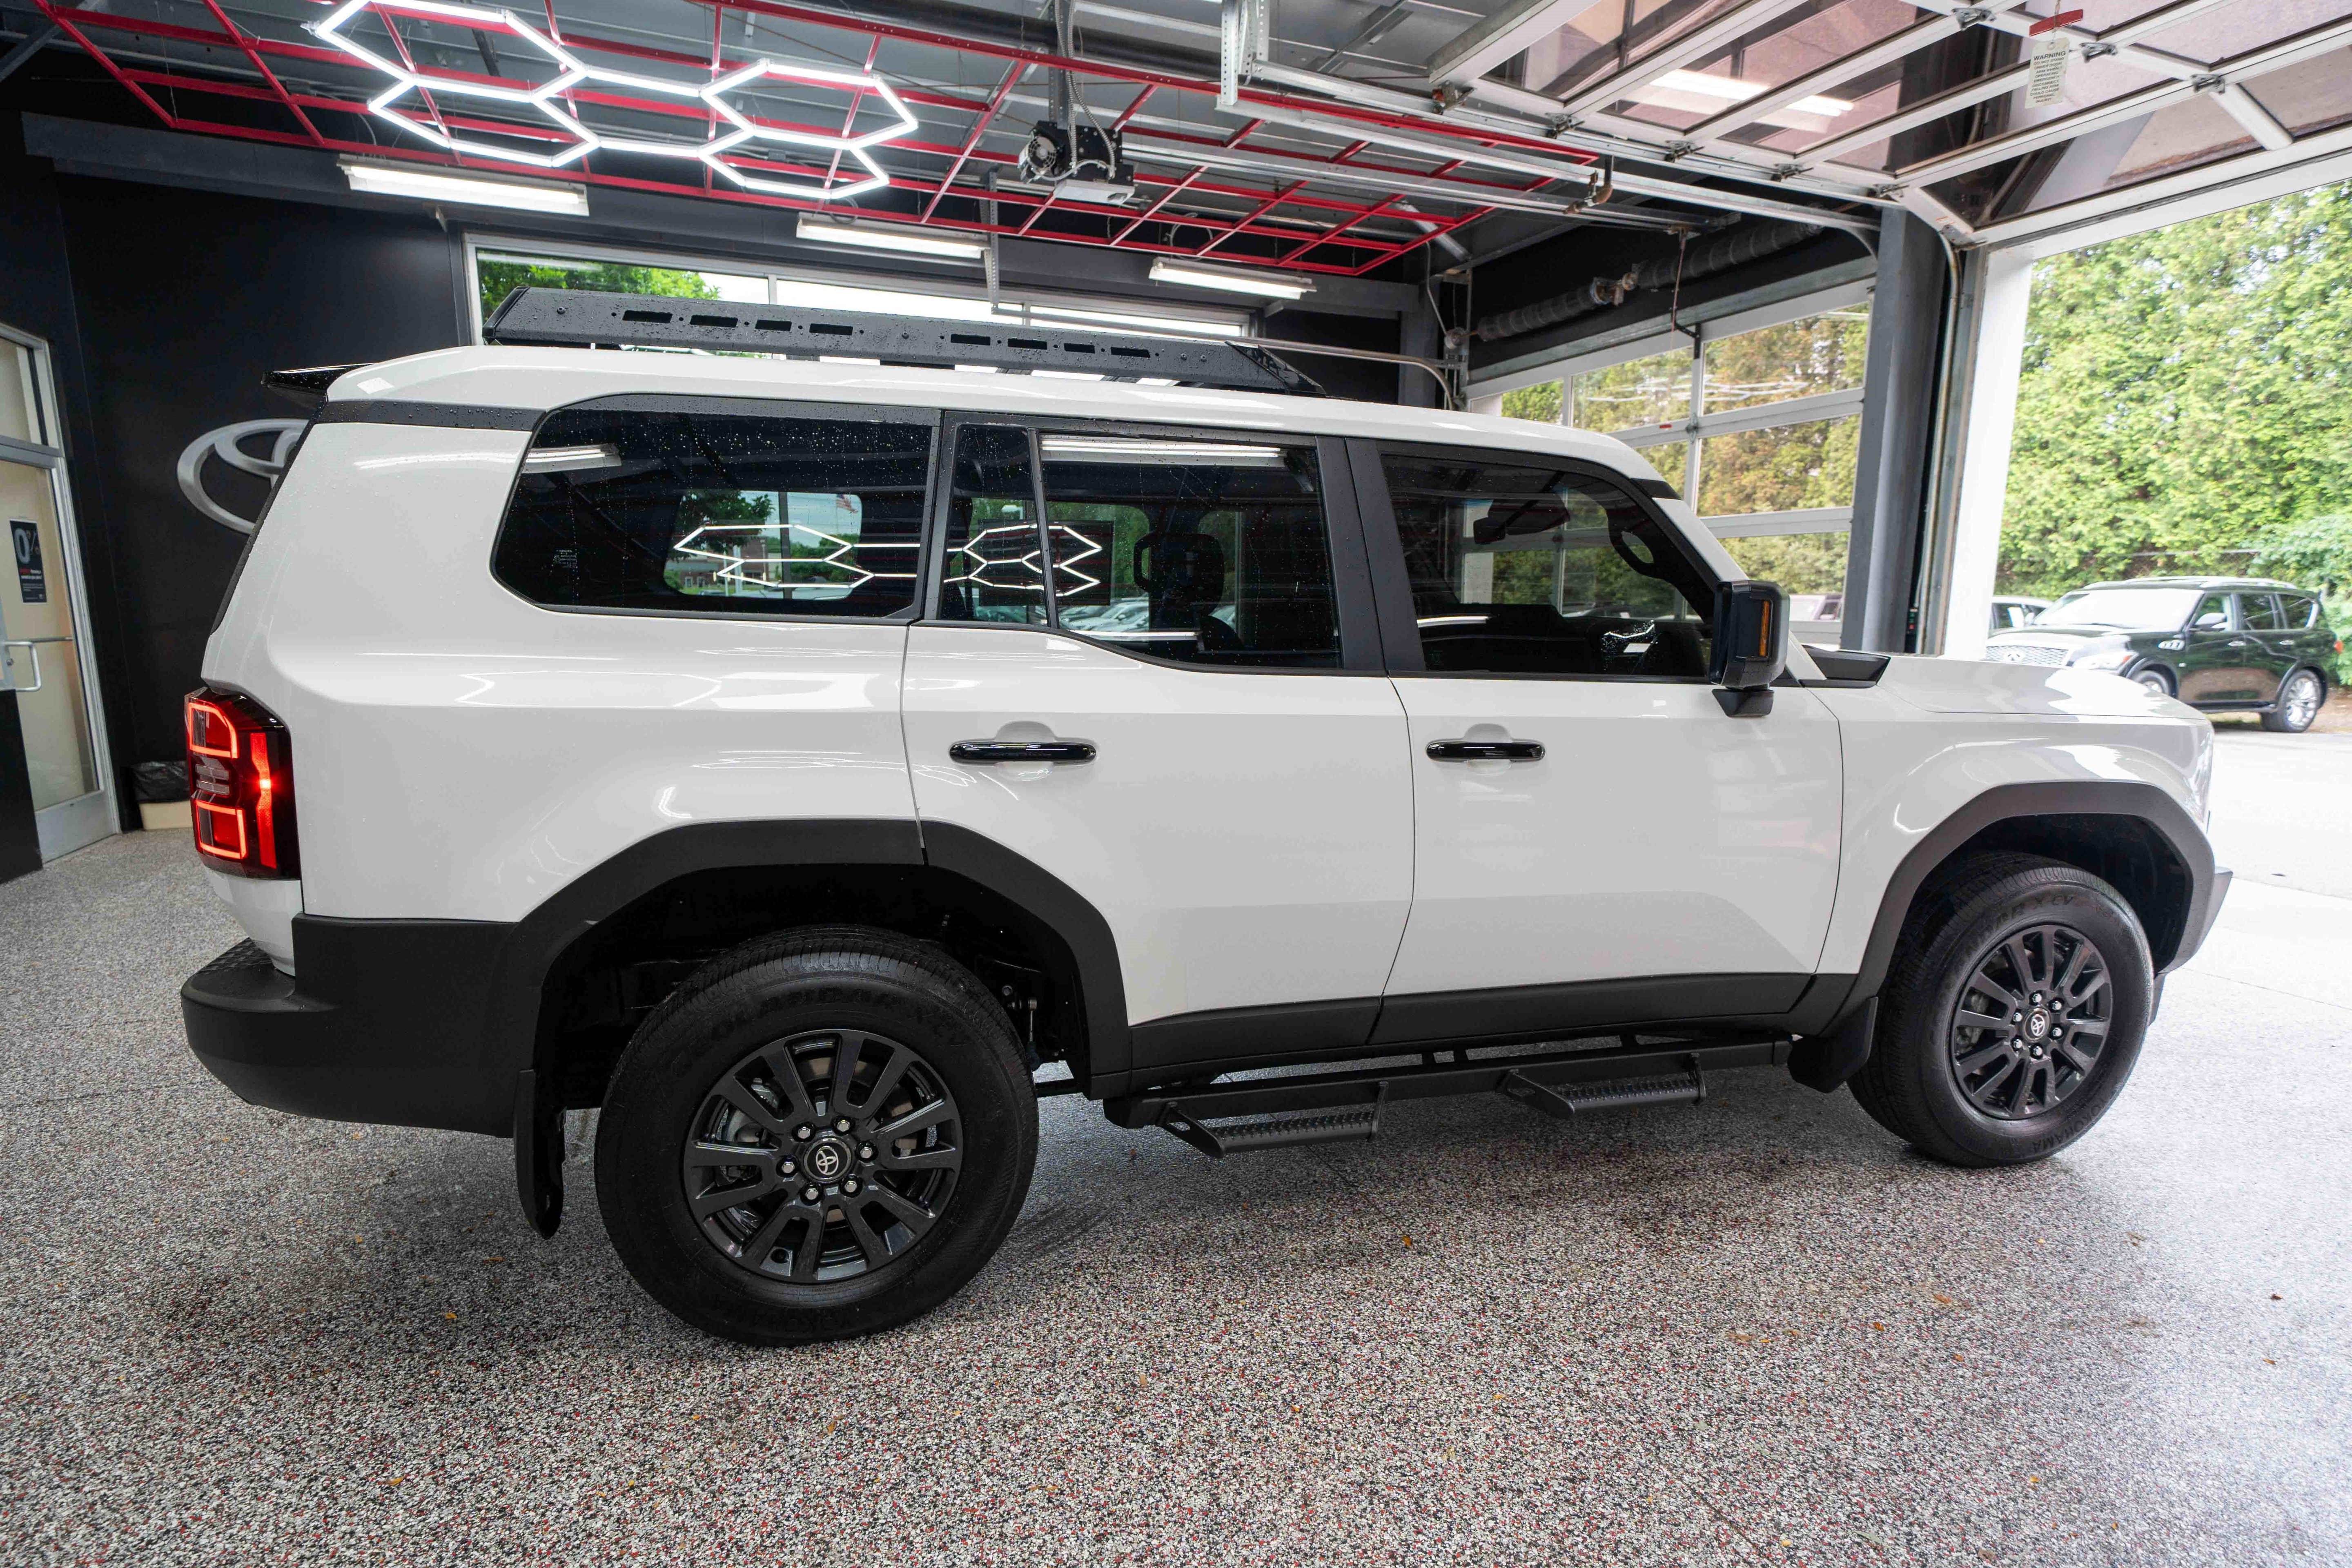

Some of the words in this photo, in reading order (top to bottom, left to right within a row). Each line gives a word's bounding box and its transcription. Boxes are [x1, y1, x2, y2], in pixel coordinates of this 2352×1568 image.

[2034, 51, 2066, 60] WARNING
[15, 528, 40, 563] 0%
[2032, 1097, 2109, 1152] YOKOHAMA
